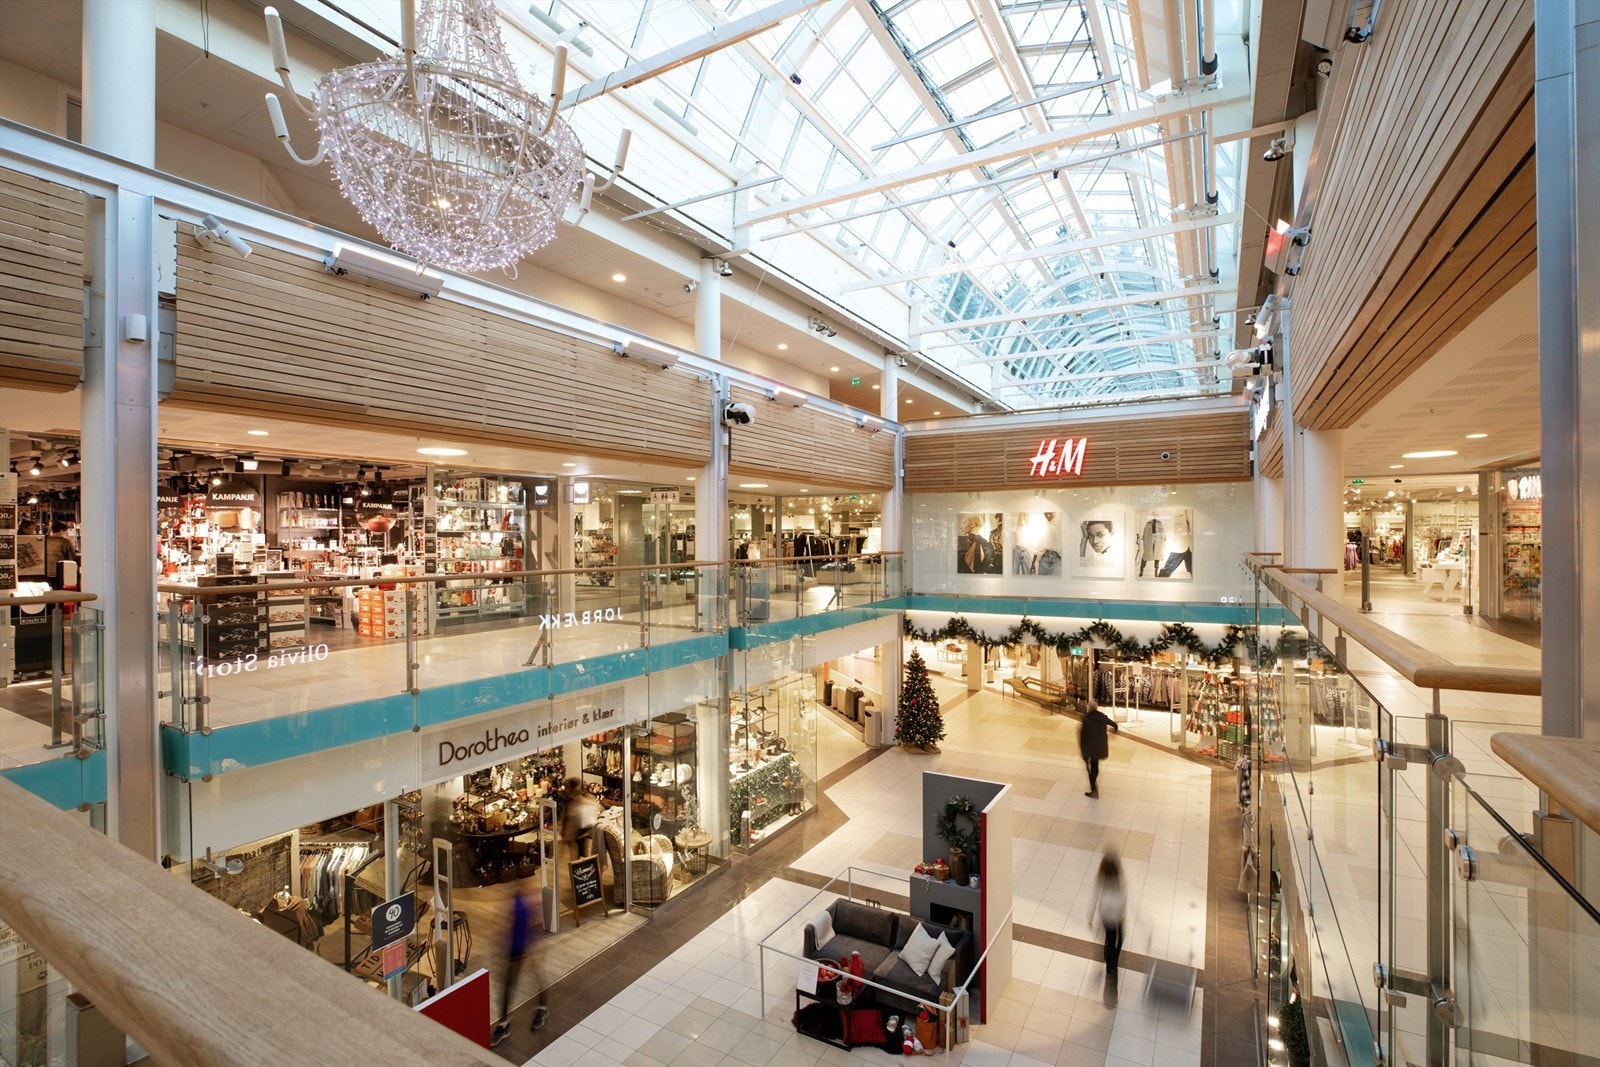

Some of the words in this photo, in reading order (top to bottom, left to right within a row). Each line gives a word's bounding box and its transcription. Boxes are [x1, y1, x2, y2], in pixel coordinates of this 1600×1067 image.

[1029, 437, 1088, 477] H&M
[212, 493, 255, 501] KAMPANJE
[362, 502, 393, 510] KAMPANJE
[439, 728, 530, 766] Dorothea
[537, 718, 579, 738] interiør
[582, 713, 590, 724] &
[593, 708, 615, 722] klær
